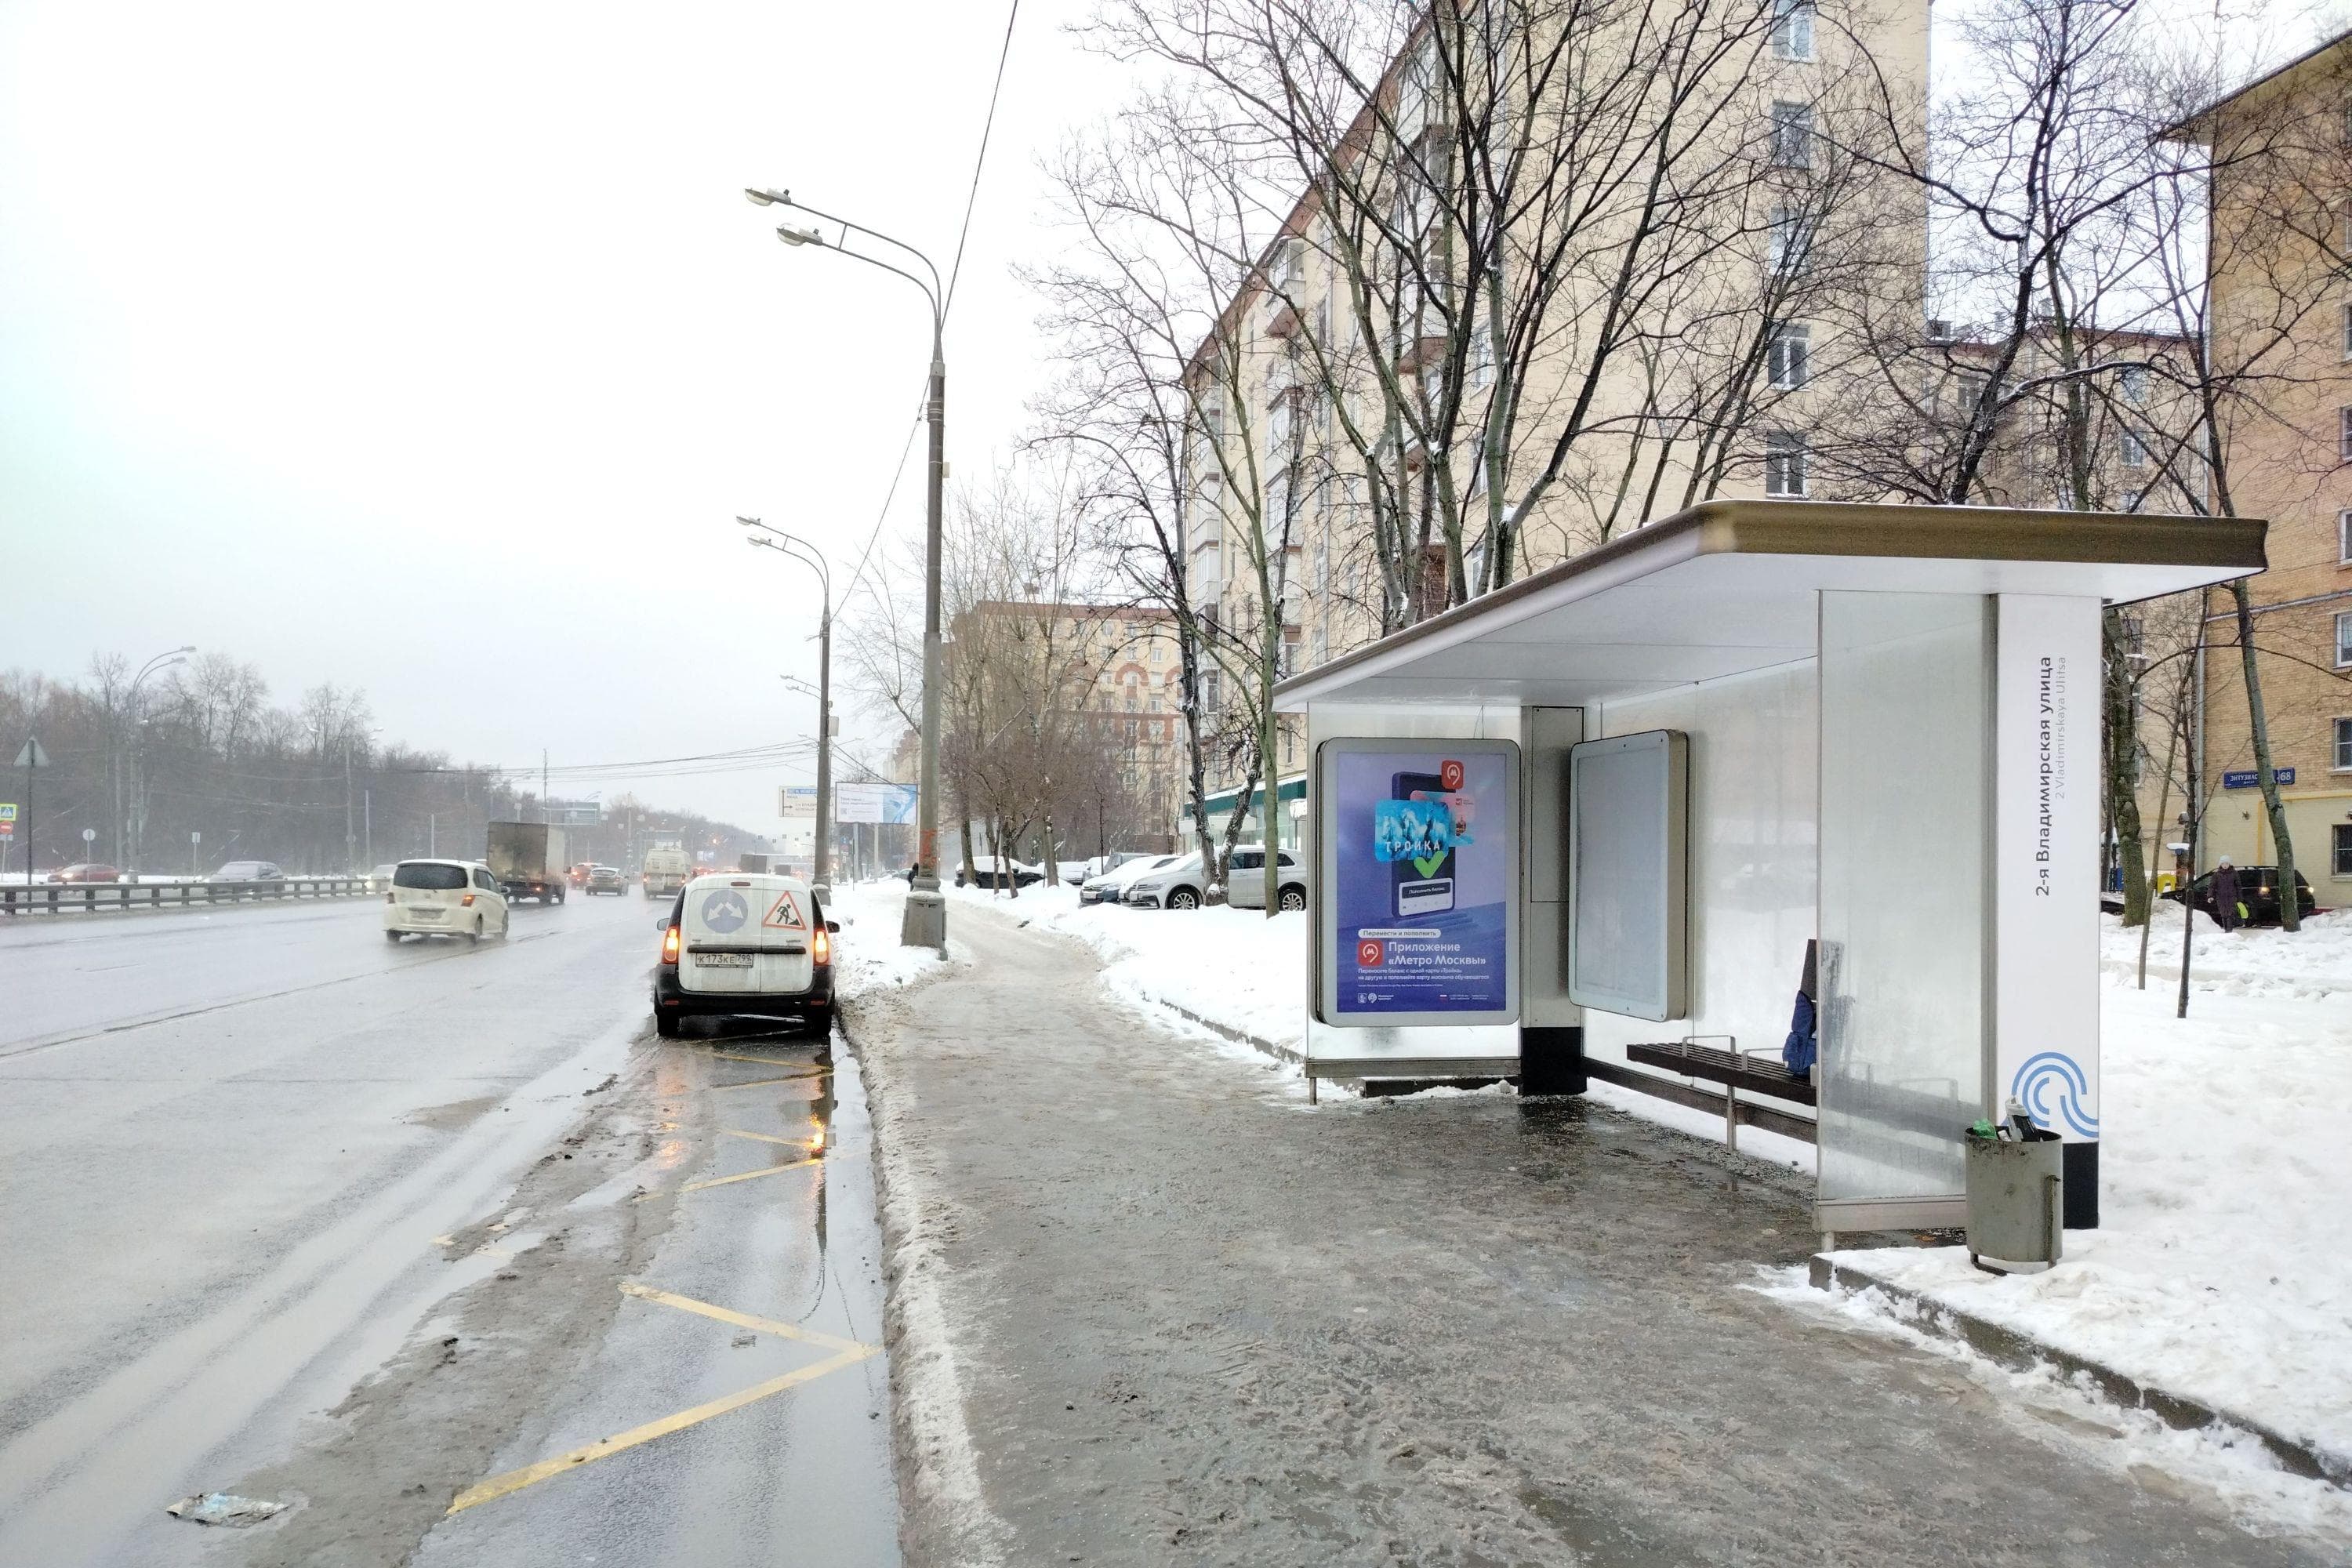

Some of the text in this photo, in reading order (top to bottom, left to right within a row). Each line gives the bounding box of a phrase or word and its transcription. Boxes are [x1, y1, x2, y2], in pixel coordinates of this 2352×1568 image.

[2056, 657, 2067, 694] Ulitsa
[2055, 698, 2067, 789] Vladimirskaya
[2036, 657, 2053, 896] 2-я Владимирская улица
[2280, 771, 2291, 781] 68
[1385, 840, 1440, 852] ТРОЙКА
[1388, 942, 1461, 953] Приложение
[1388, 955, 1486, 967] «Метро Москвы»
